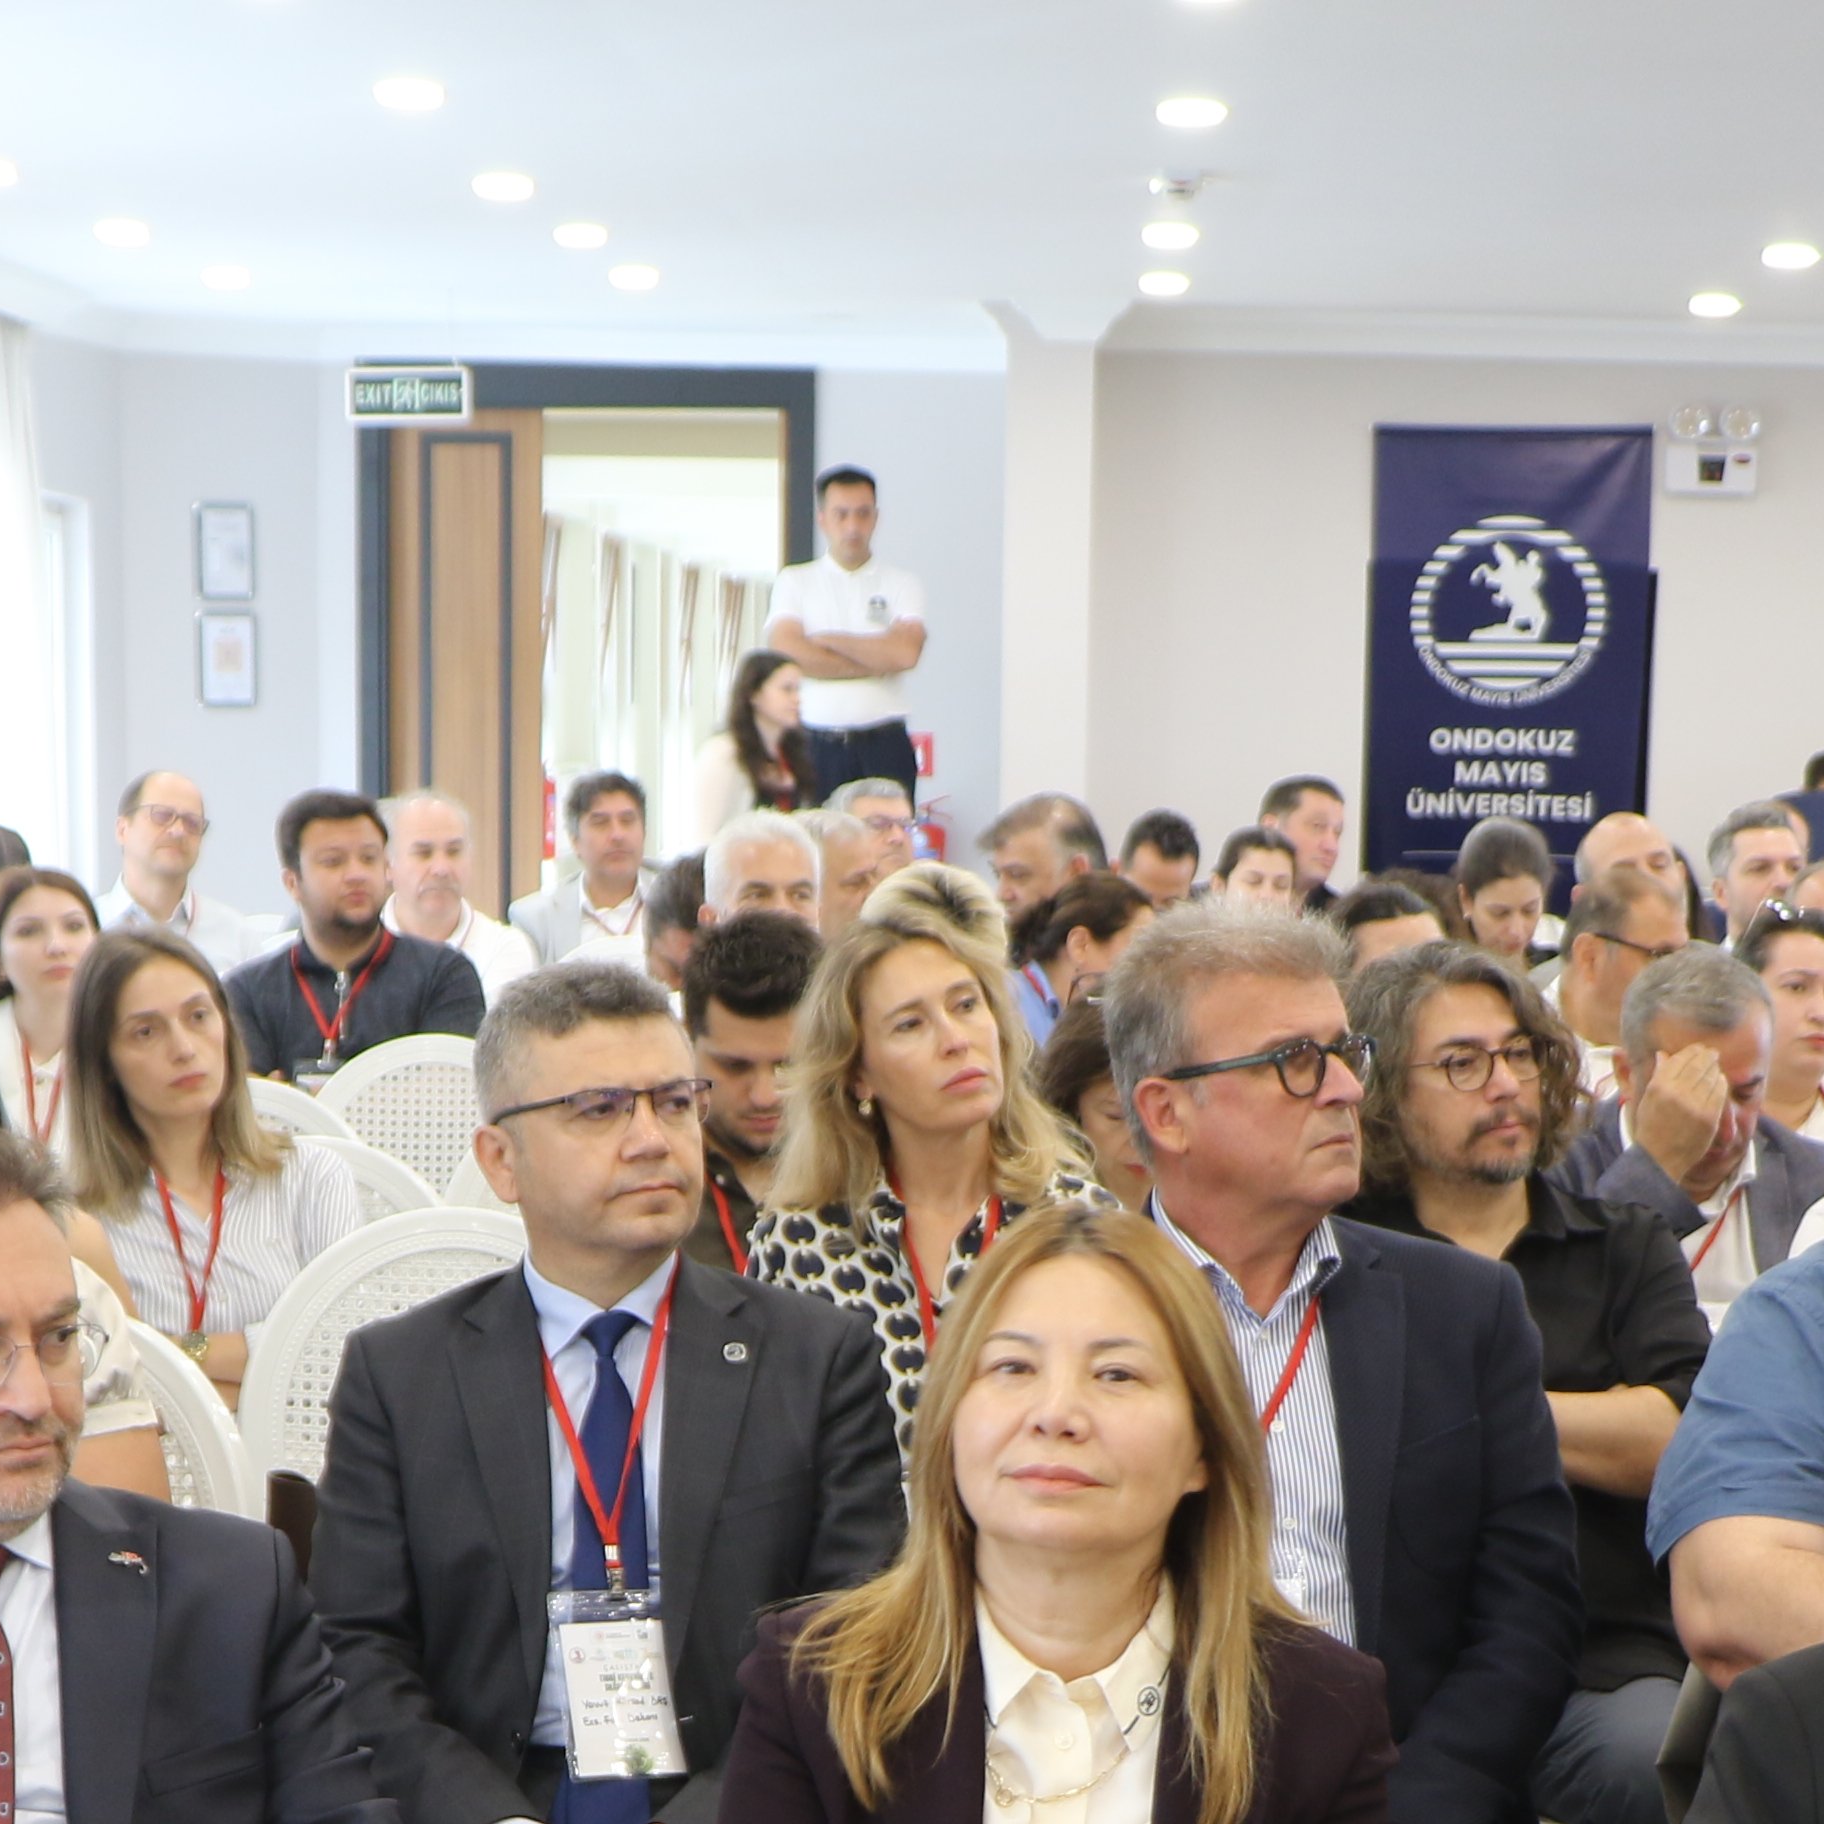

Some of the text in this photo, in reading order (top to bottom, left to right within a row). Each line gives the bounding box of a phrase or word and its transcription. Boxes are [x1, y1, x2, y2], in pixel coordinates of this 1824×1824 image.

[355, 382, 393, 406] EXIT
[1429, 728, 1576, 757] ONDOKUZ
[1454, 762, 1548, 787] MAYIS
[1406, 788, 1594, 820] ÜNİVERSİTESİ
